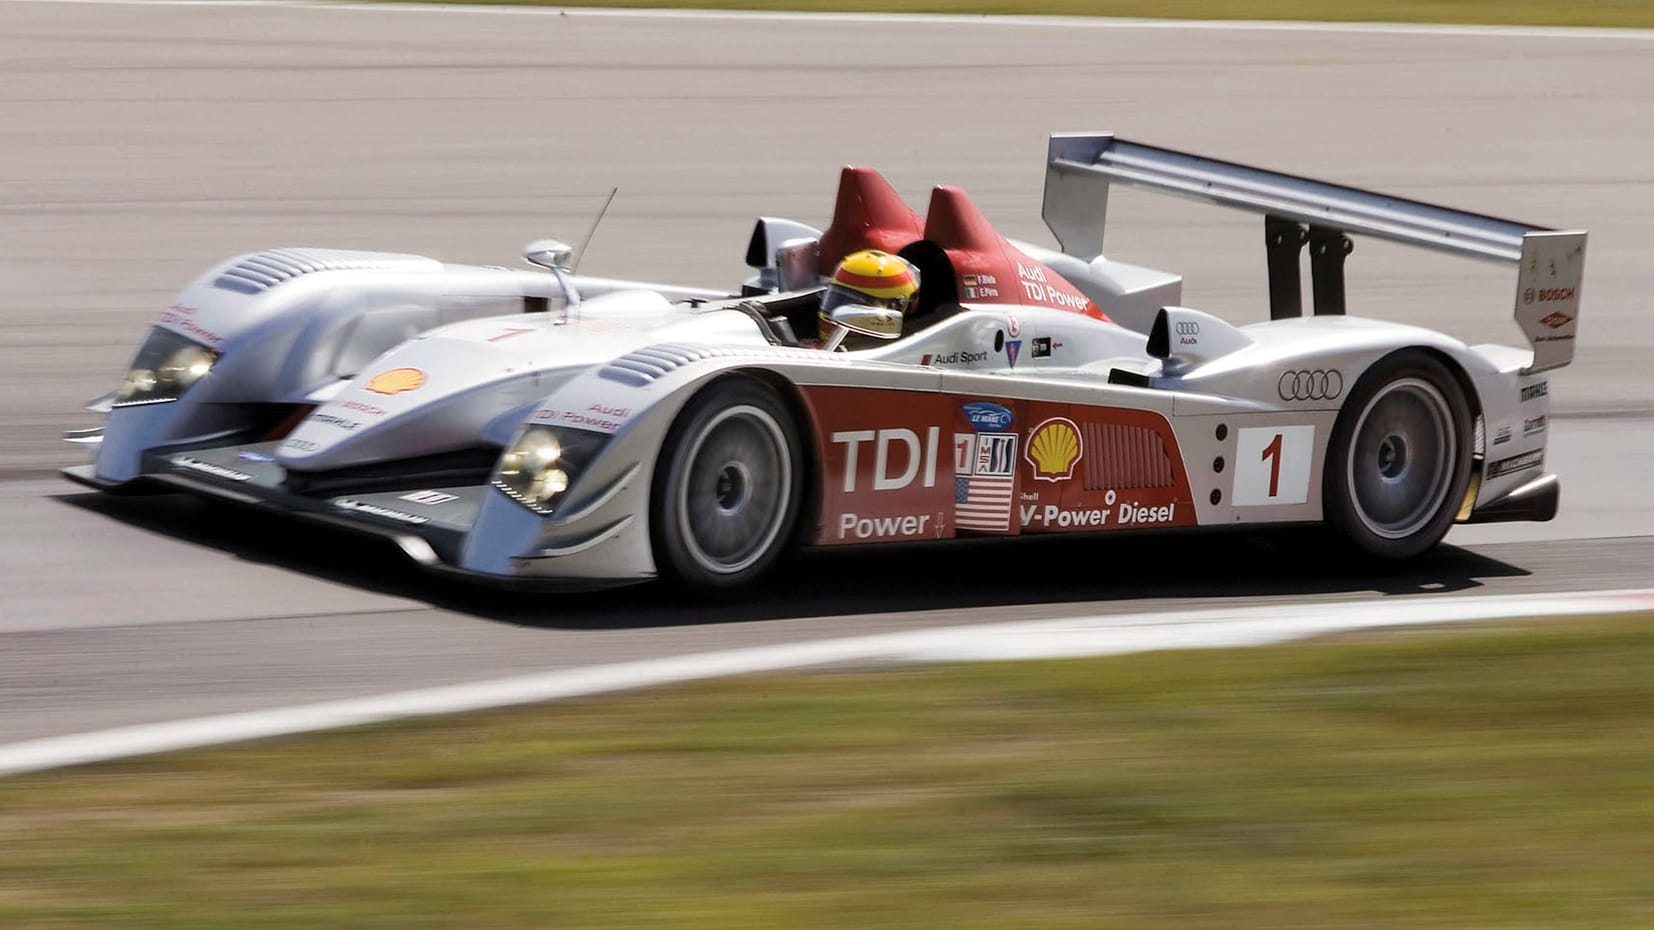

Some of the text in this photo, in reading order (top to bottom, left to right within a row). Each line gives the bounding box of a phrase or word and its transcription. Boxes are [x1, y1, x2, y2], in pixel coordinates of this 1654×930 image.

[1018, 262, 1047, 283] Audi
[1021, 280, 1091, 311] TDI Power
[1537, 287, 1575, 302] BOSCH
[1180, 336, 1197, 345] Audi
[935, 351, 988, 366] Audi Sport
[563, 411, 621, 430] Power
[588, 403, 632, 418] Audi
[831, 426, 940, 493] TDI
[957, 439, 969, 469] 1
[1261, 433, 1283, 498] 1
[839, 510, 931, 540] Power
[1020, 501, 1175, 527] V-Power Diesel
